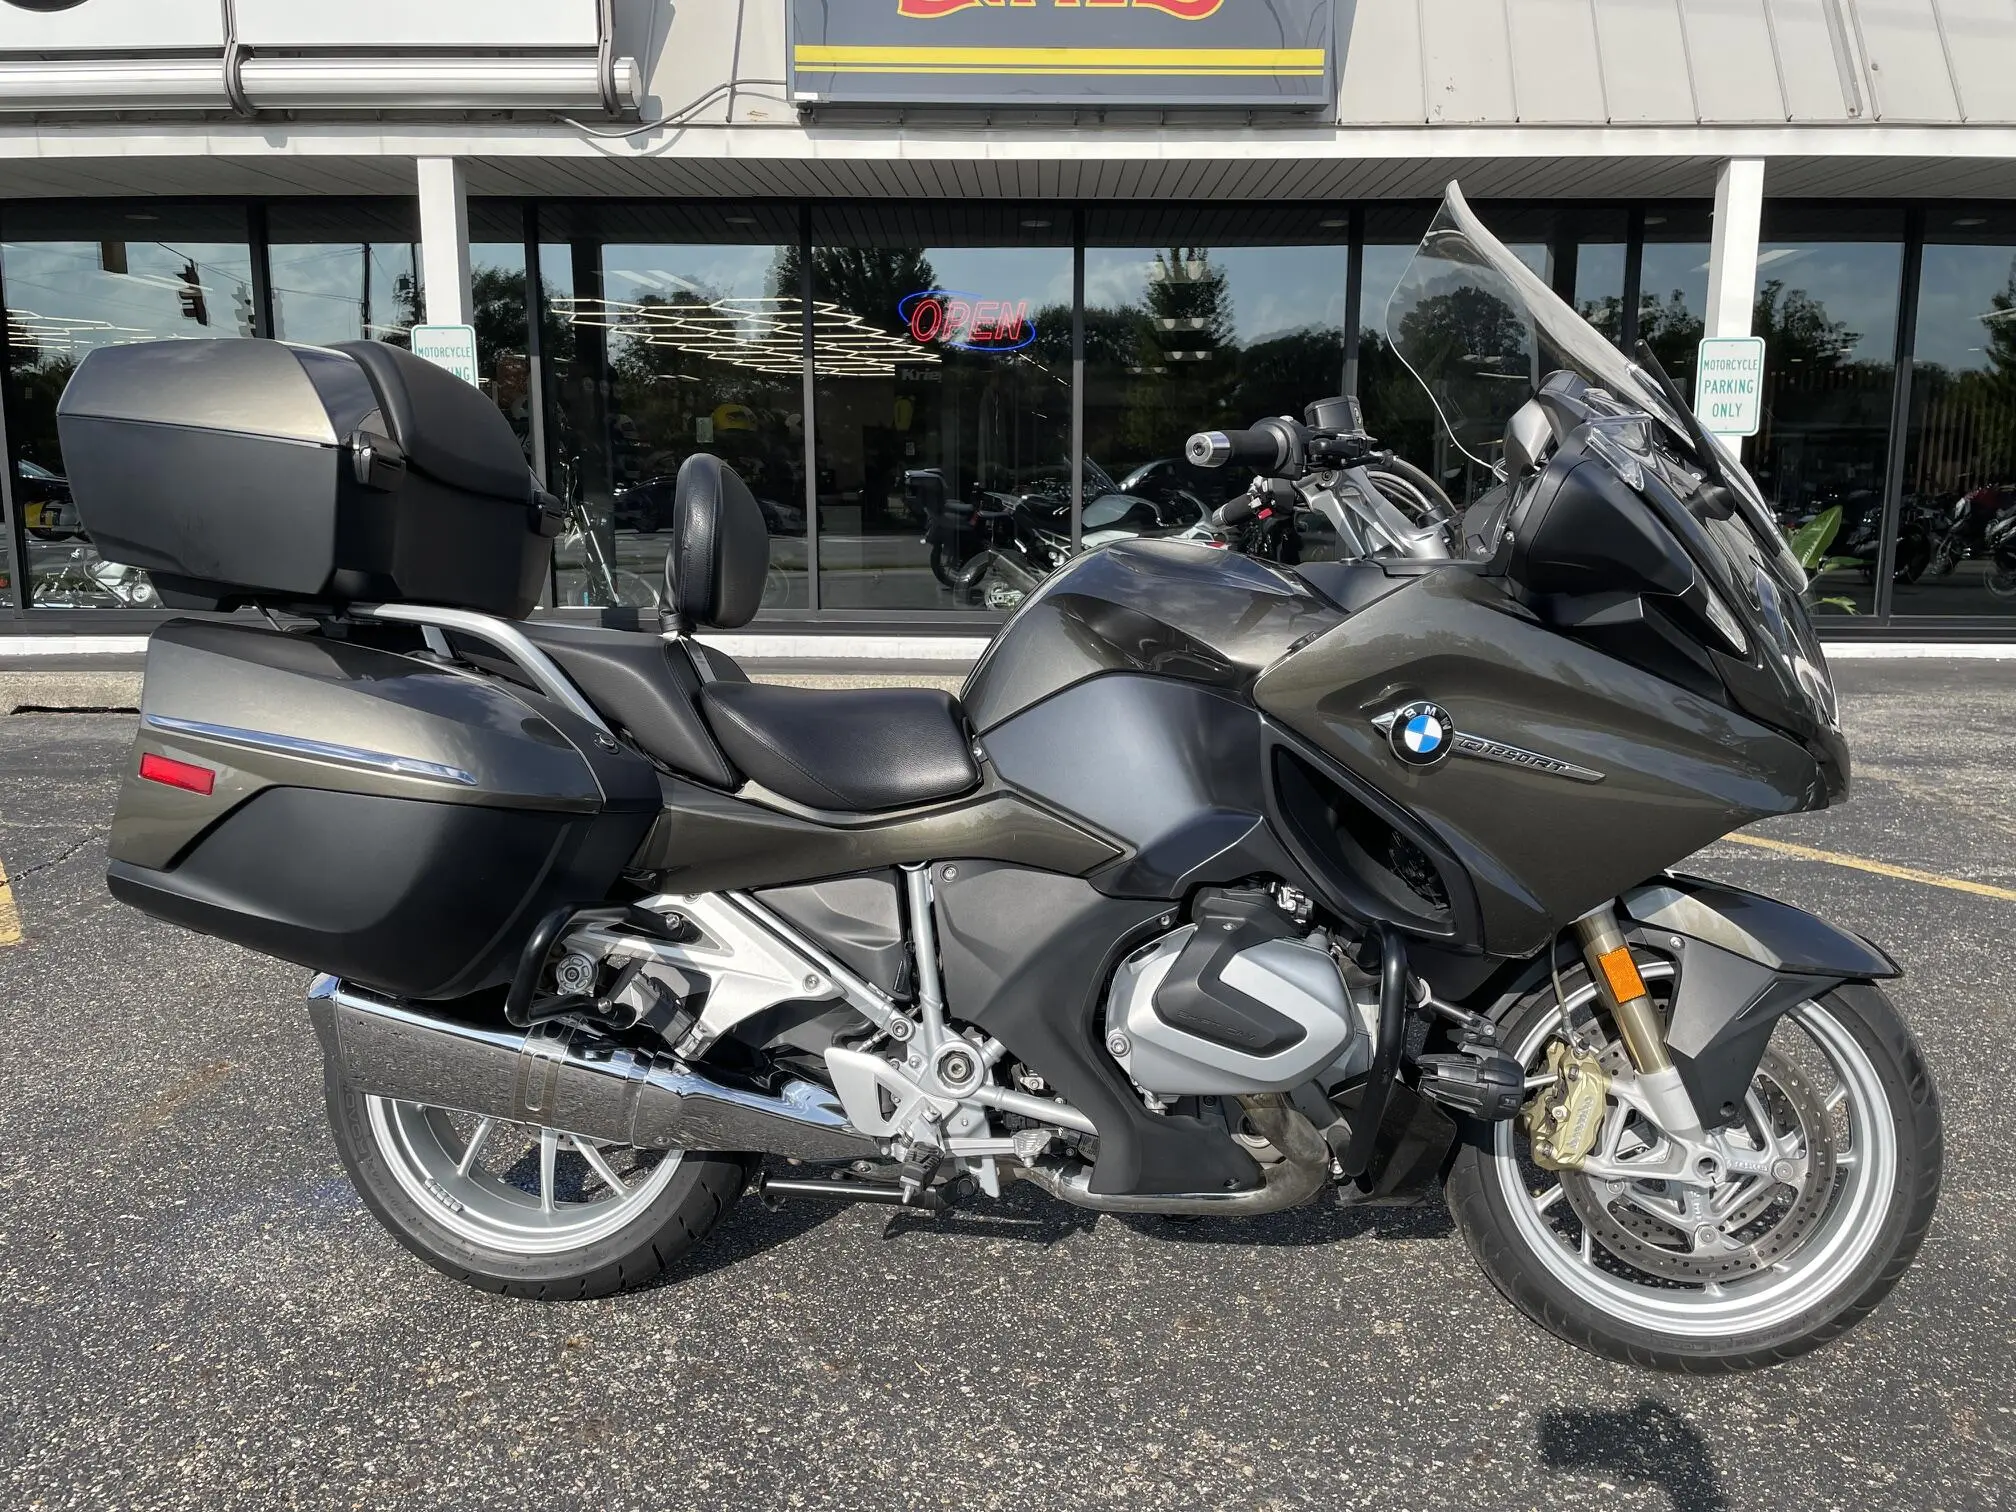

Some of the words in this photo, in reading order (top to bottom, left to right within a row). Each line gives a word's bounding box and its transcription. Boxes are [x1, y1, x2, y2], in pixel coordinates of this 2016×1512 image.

[911, 299, 1027, 342] OPEN
[417, 346, 472, 358] MOTORCYCLE
[1703, 359, 1758, 371] MOTORCYCLE
[1704, 379, 1754, 394] PARKING
[1712, 402, 1743, 418] ONLY
[1404, 705, 1452, 730] BMW
